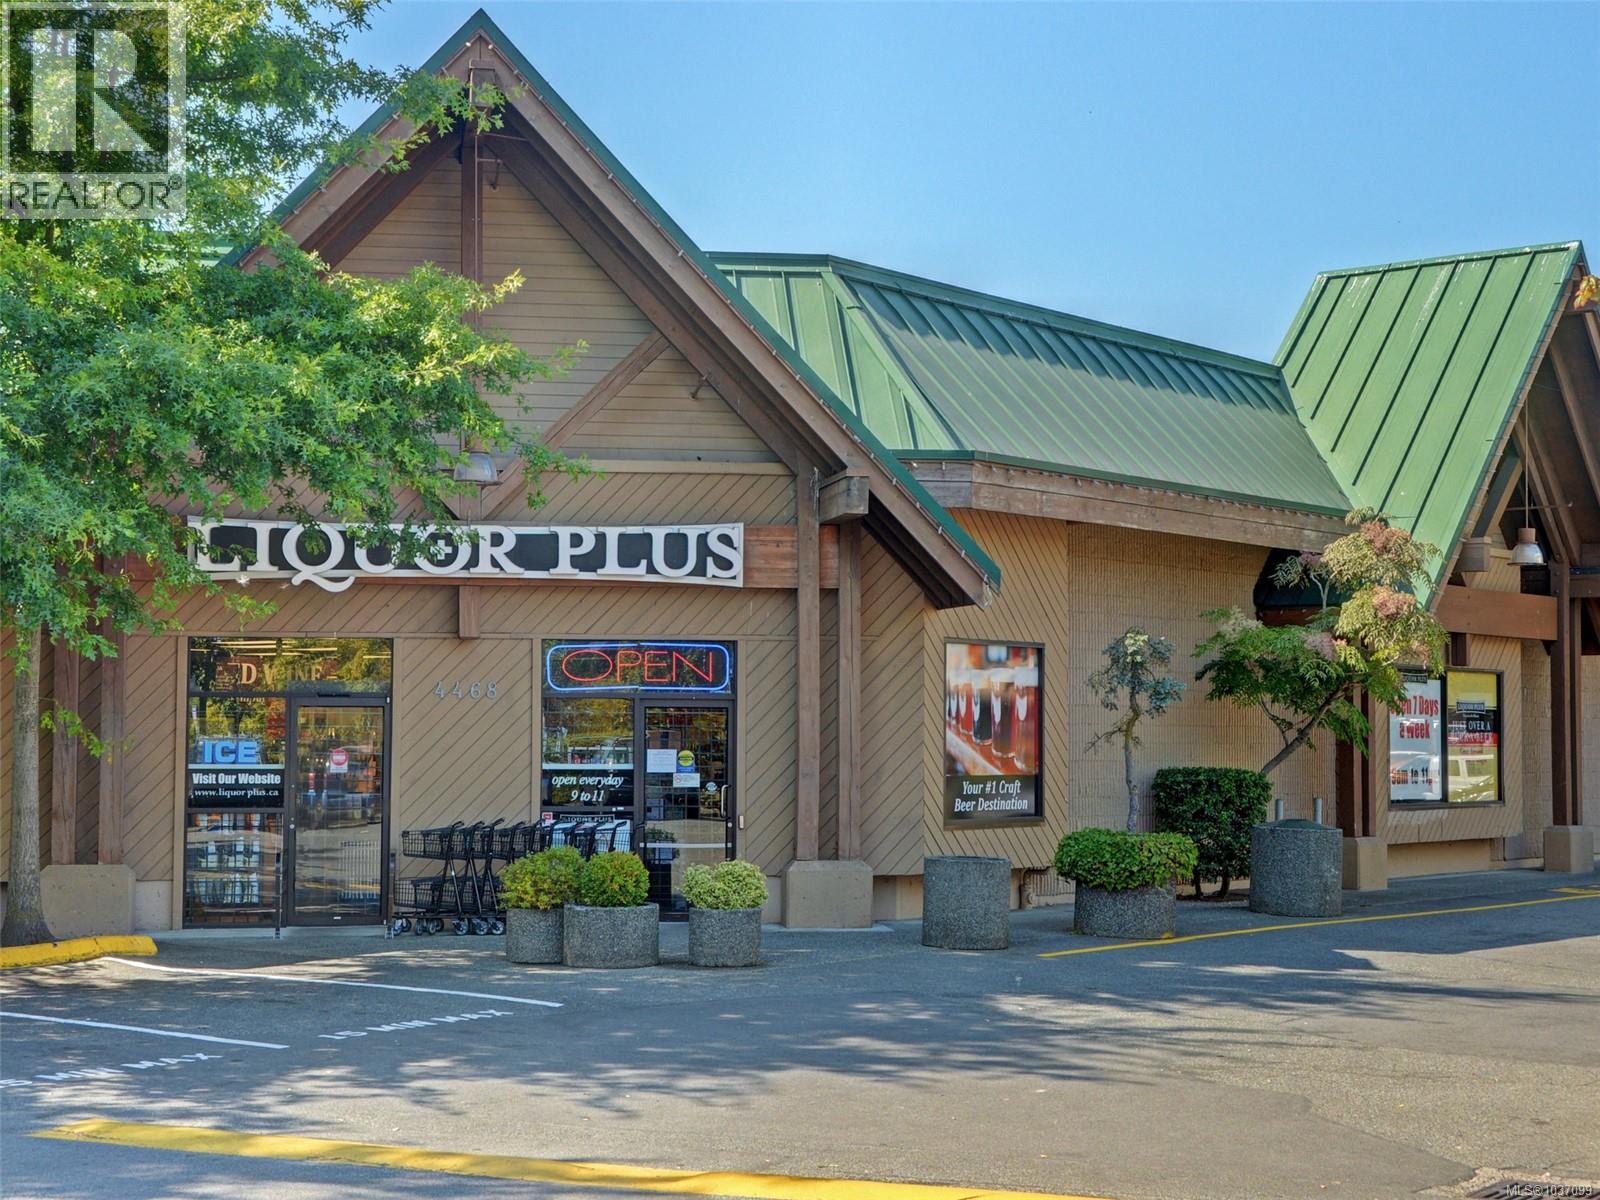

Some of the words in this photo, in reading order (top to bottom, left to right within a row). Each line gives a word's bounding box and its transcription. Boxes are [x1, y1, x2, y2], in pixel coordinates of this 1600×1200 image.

[188, 521, 525, 592] LIQUOR
[550, 524, 742, 578] PLUS
[561, 649, 713, 682] OPEN
[434, 680, 498, 699] 4468
[1413, 695, 1418, 715] 7
[1419, 695, 1439, 717] Days
[1399, 722, 1405, 739] a
[1407, 719, 1431, 739] week
[1468, 720, 1485, 730] OVER
[1486, 721, 1491, 731] A
[202, 739, 258, 765] ICE
[192, 773, 216, 785] Visit
[218, 773, 237, 785] Our
[238, 773, 281, 785] Website
[552, 776, 577, 788] open
[579, 773, 624, 788] everyday
[1411, 768, 1419, 785] to
[571, 789, 579, 801] 9
[580, 791, 591, 801] to
[591, 790, 605, 802] 11
[962, 781, 983, 795] Your
[985, 781, 996, 794] #1
[999, 779, 1022, 796] Craft
[954, 798, 976, 812] Beer
[977, 797, 1028, 811] Destination
[365, 1019, 438, 1032] MIN
[430, 1009, 514, 1023] MAX
[0, 1078, 33, 1088] 5
[120, 1052, 224, 1069] MAX
